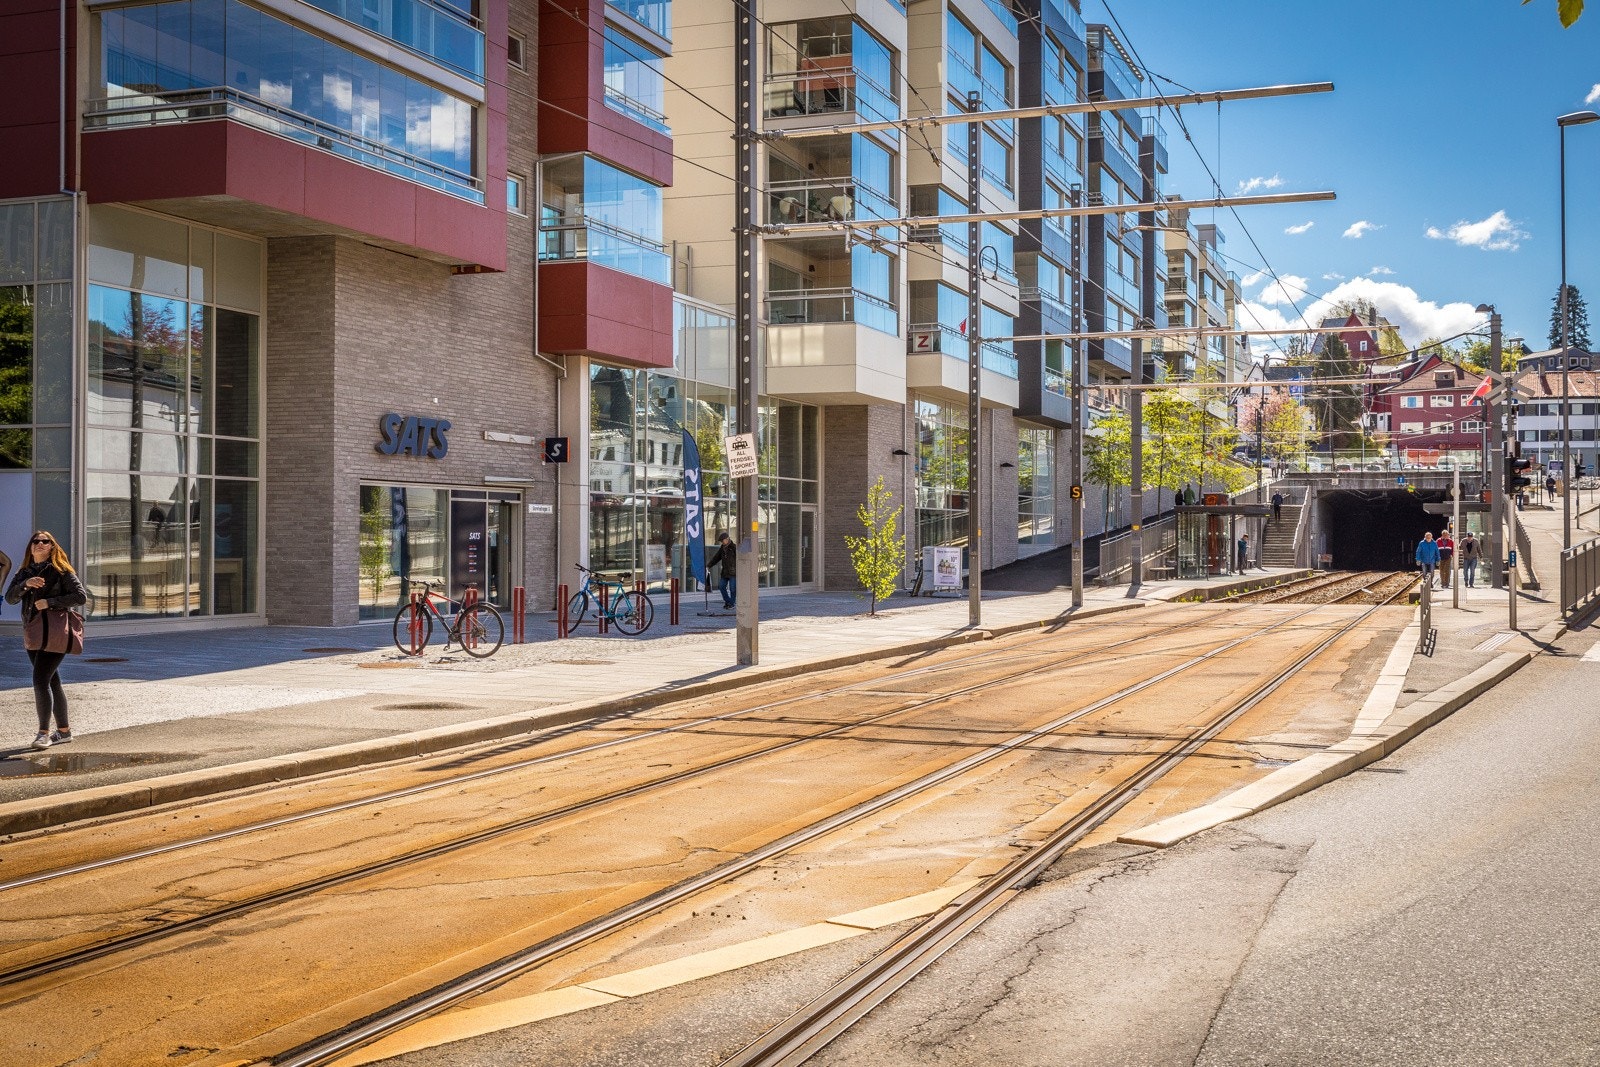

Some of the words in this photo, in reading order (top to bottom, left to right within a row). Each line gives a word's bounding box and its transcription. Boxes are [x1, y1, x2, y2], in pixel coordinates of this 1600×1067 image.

[376, 412, 452, 460] SATS
[551, 443, 562, 457] S
[734, 462, 755, 470] SPORET
[731, 468, 757, 476] FORBUDT
[1072, 486, 1080, 497] S
[469, 532, 481, 540] SATS
